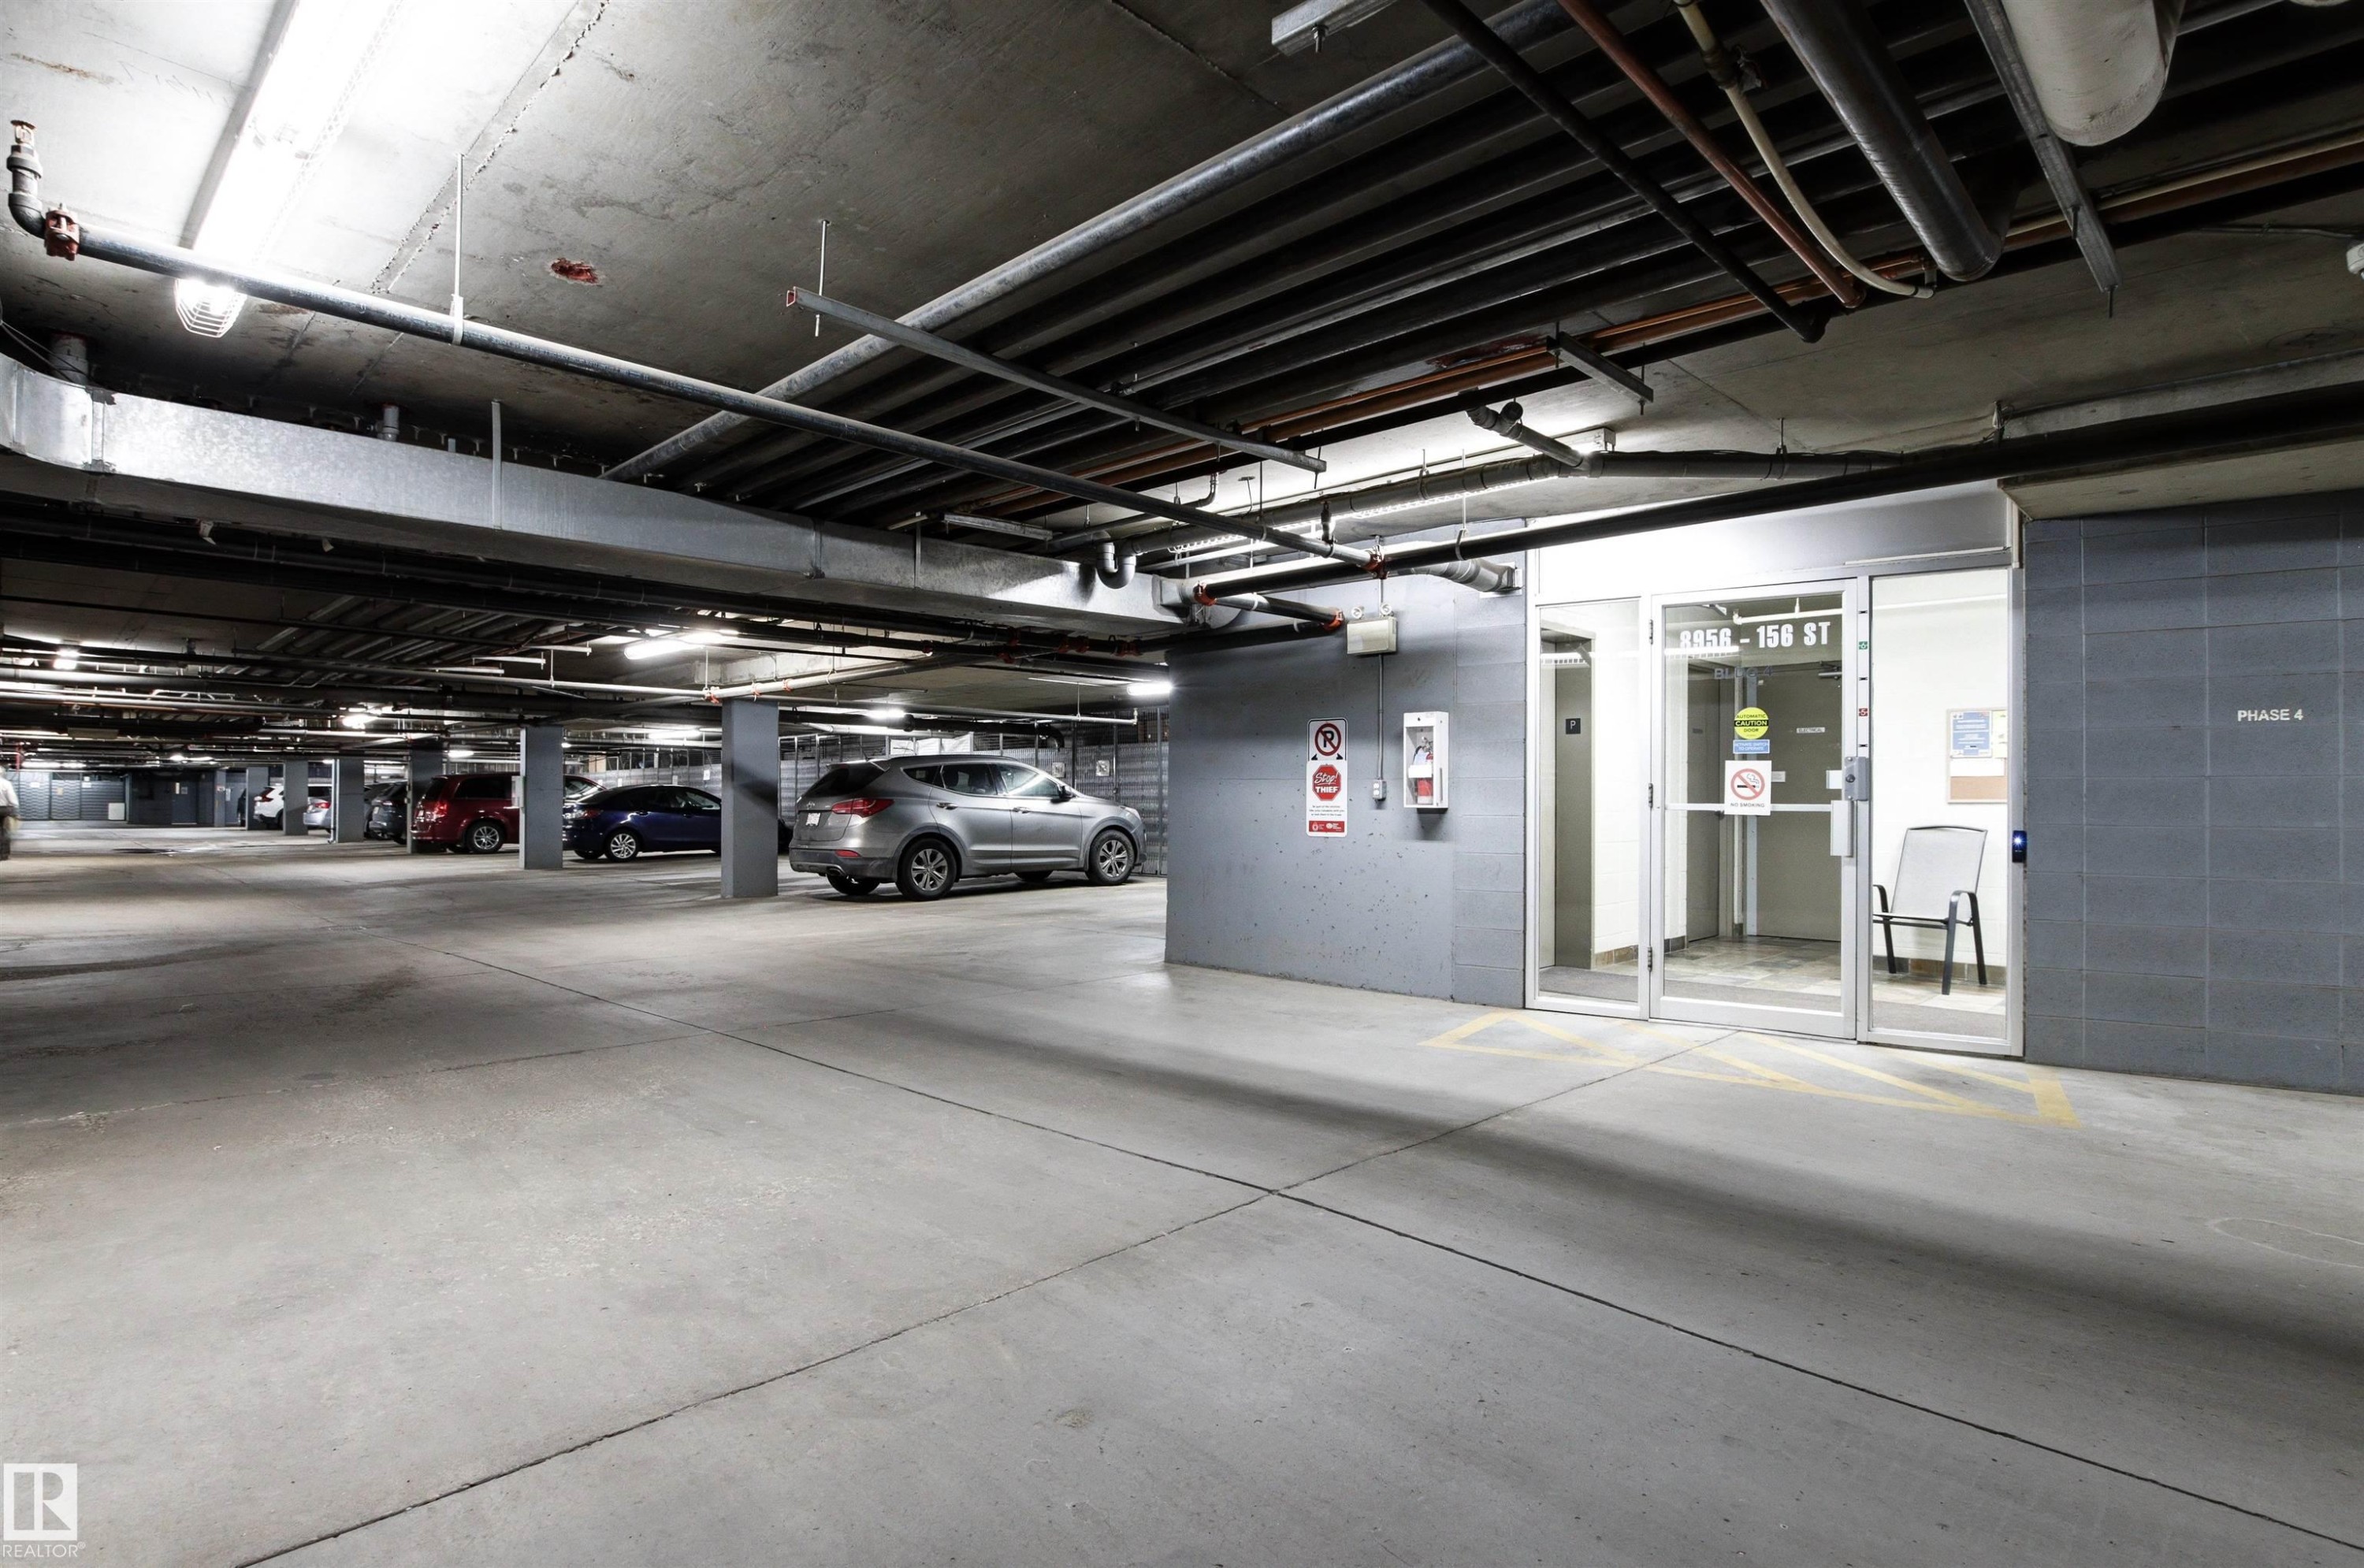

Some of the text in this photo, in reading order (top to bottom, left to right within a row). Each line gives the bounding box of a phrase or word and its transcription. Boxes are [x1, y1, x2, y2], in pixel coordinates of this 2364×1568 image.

[1680, 628, 1733, 649] 8956
[1756, 624, 1793, 648] 156
[1804, 622, 1831, 646] ST
[2237, 708, 2303, 722] PHASE 4
[1570, 720, 1576, 730] P
[1314, 771, 1339, 785] Stop!
